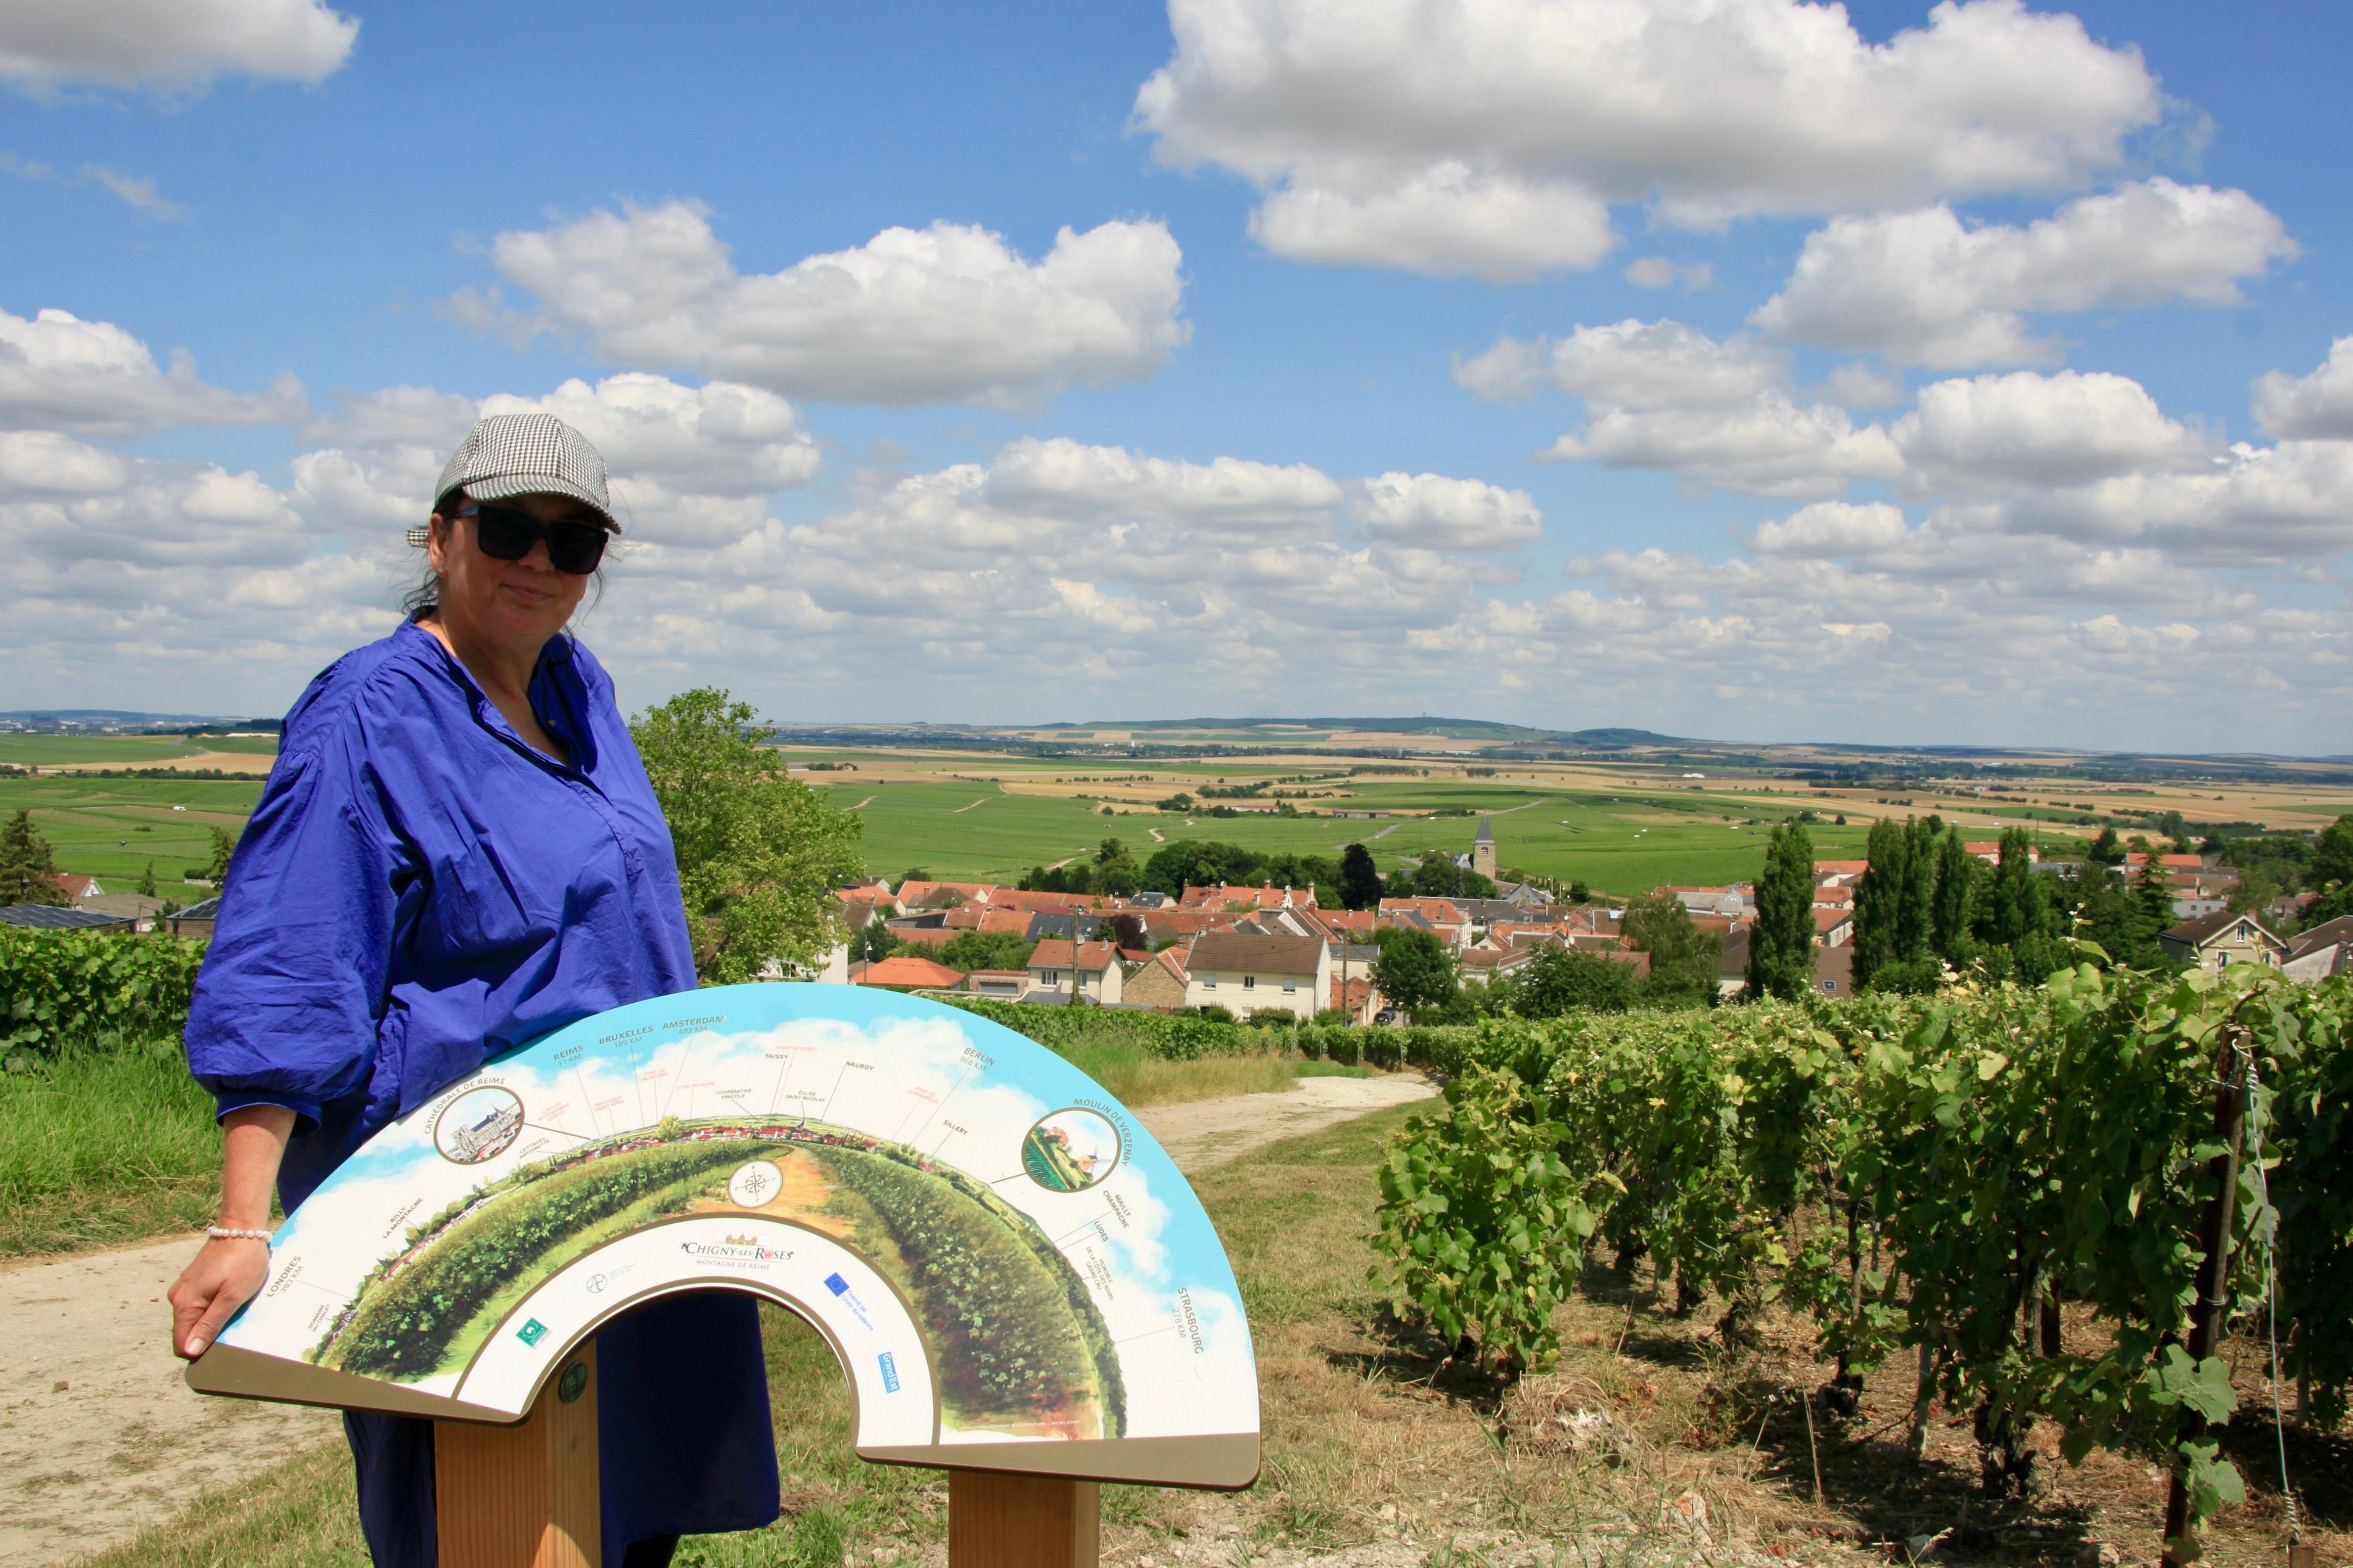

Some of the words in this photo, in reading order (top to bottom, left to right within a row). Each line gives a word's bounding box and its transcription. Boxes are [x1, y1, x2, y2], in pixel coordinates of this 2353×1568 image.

[663, 1016, 725, 1029] AMSTERDAM
[599, 1026, 654, 1044] BRUXELLES
[554, 1045, 583, 1060] REIMS
[567, 1054, 581, 1063] KM
[963, 1047, 996, 1066] BERLIN
[845, 1060, 874, 1071] NAUROY
[959, 1056, 973, 1066] 966
[974, 1062, 987, 1072] KM
[425, 1087, 463, 1134] CATHÉDRALE
[464, 1081, 476, 1090] DE
[786, 1094, 826, 1102] SAINT-NICOLAS
[942, 1119, 968, 1135] SILLERY
[1074, 1099, 1112, 1114] MOULIN
[1110, 1112, 1122, 1123] DE
[1119, 1122, 1132, 1166] VERZENAY
[519, 1139, 550, 1159] ANTOINETTE
[520, 1137, 546, 1154] COTTAGES
[390, 1206, 405, 1222] RILLY
[391, 1197, 423, 1230] MONTAGNE
[1103, 1190, 1129, 1229] CHAMPAGNE
[1114, 1194, 1132, 1216] MAILLY
[1094, 1220, 1109, 1241] LUDES
[696, 1259, 735, 1267] MONTAGNE
[1086, 1262, 1097, 1279] GRAND
[1099, 1258, 1113, 1283] VIGNOBLE
[266, 1256, 301, 1297] LONDRES
[281, 1279, 293, 1294] 393
[292, 1266, 303, 1278] KM
[846, 1289, 862, 1306] Financé
[1104, 1284, 1114, 1301] NOIRS
[308, 1304, 325, 1329] DOMAINE
[312, 1323, 319, 1332] DU
[318, 1304, 331, 1324] CHALET
[841, 1294, 853, 1308] l'Union
[852, 1308, 874, 1331] européenne
[1178, 1287, 1203, 1354] STRASBOURG
[1172, 1308, 1182, 1323] 278
[1177, 1324, 1187, 1338] KM
